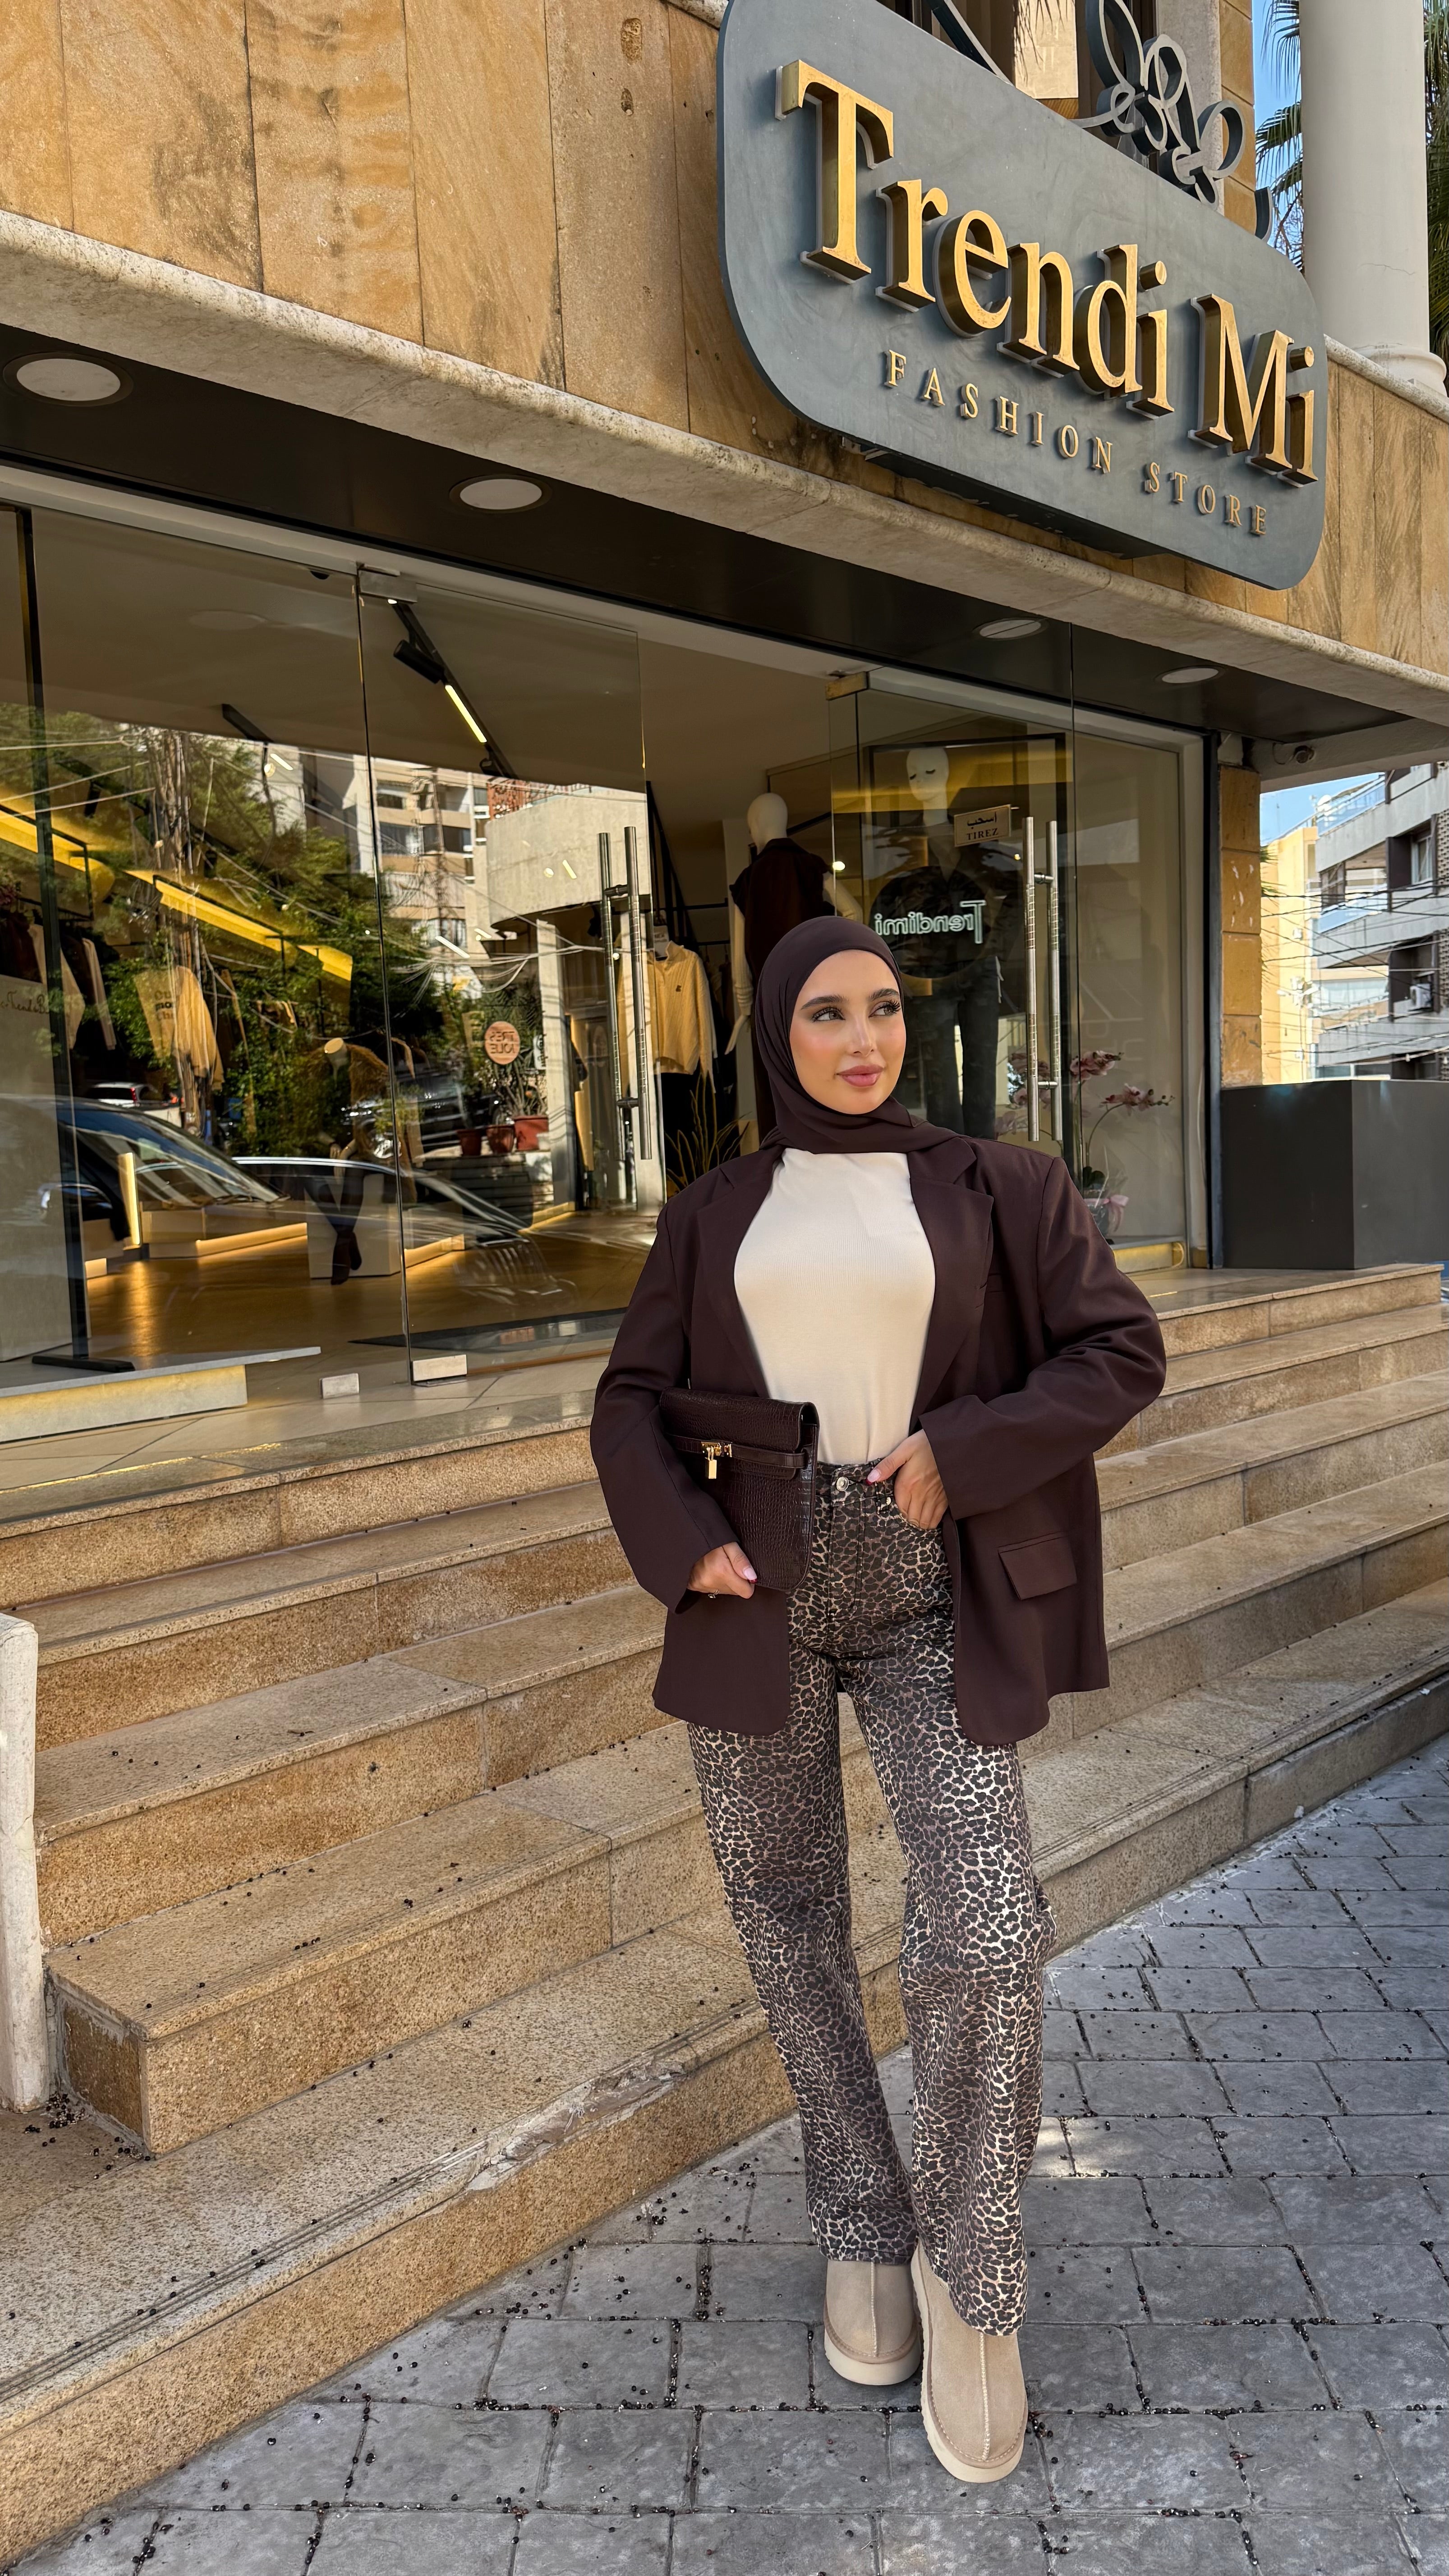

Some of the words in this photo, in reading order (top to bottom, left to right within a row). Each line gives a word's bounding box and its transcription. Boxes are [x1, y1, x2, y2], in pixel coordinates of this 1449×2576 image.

[777, 59, 1174, 420] Trendi
[1192, 293, 1319, 485] Mi
[885, 350, 1113, 474] FASHION
[1145, 461, 1267, 535] STORE
[966, 828, 998, 840] TIREZ
